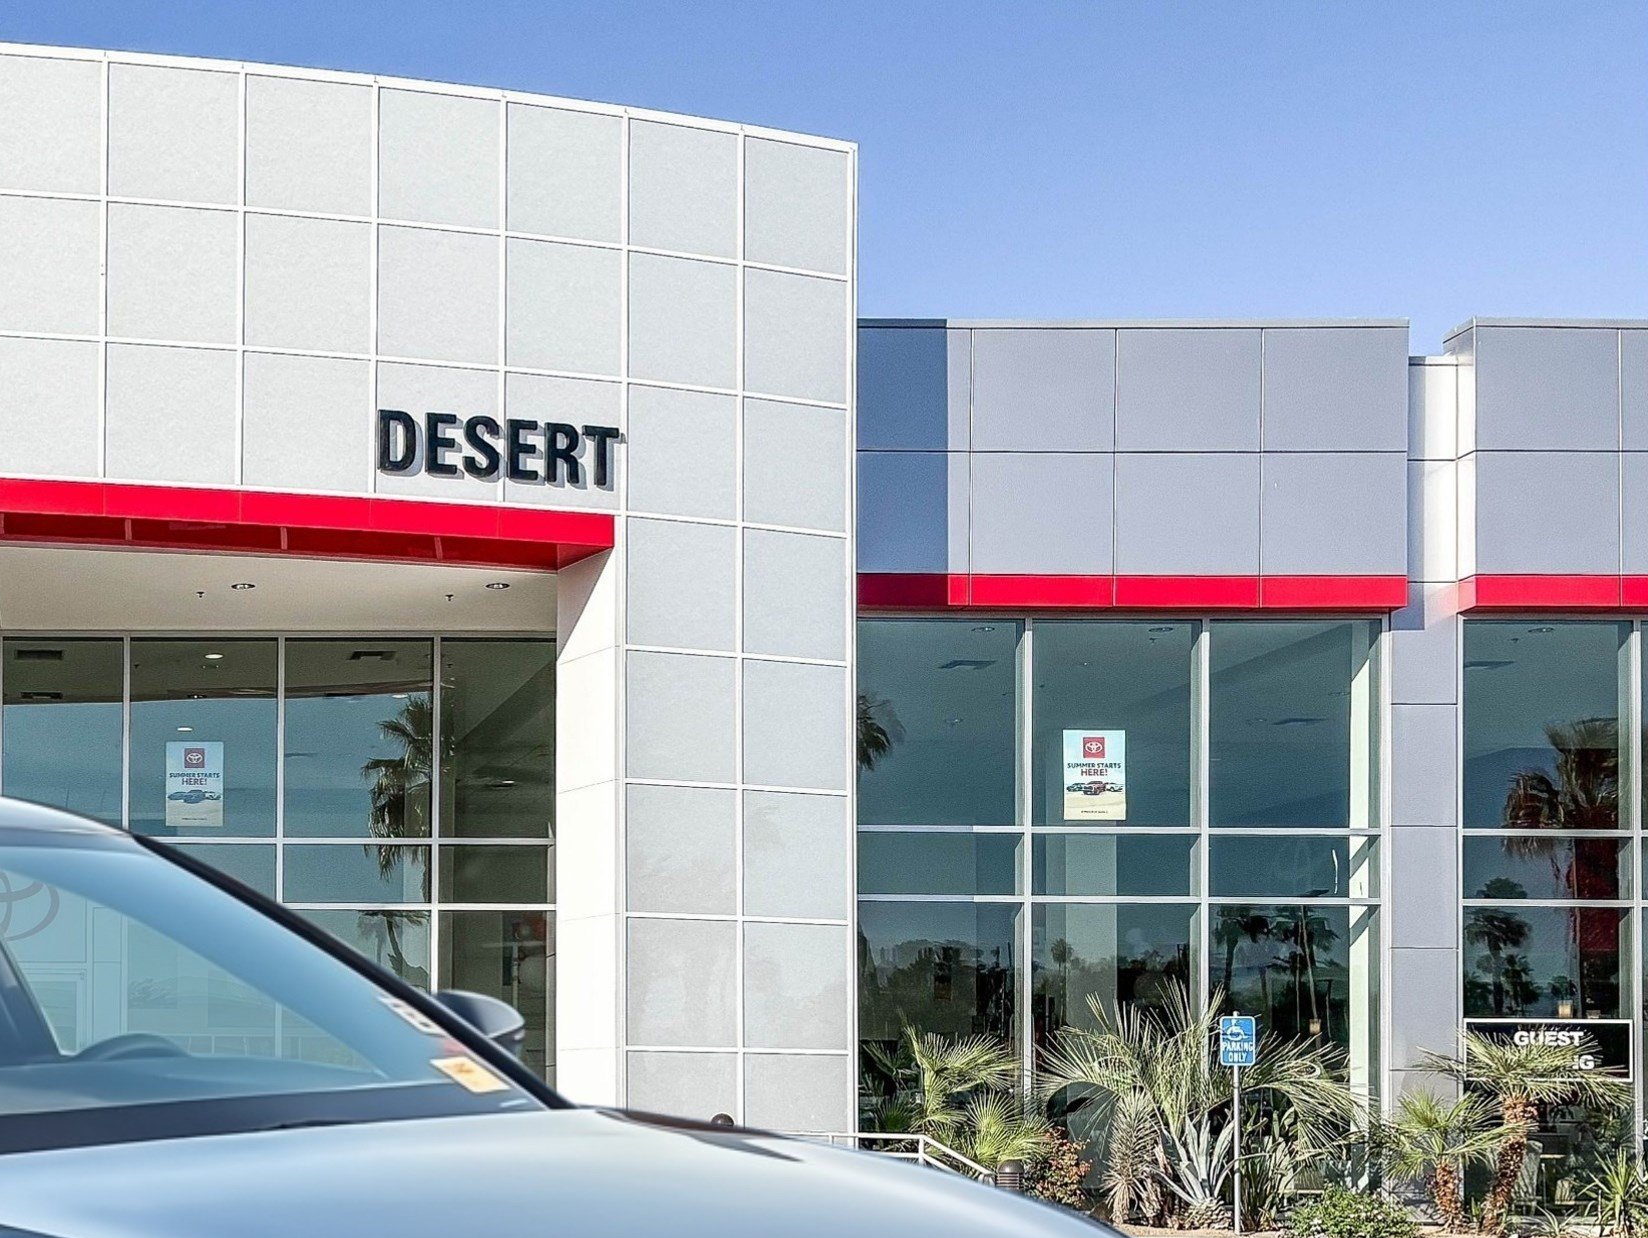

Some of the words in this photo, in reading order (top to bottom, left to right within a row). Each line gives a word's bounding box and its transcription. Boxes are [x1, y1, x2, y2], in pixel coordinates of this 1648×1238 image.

[376, 408, 620, 487] DESERT
[1513, 1031, 1584, 1046] GUEST
[1222, 1041, 1254, 1051] PARKING
[1228, 1051, 1247, 1062] ONLY
